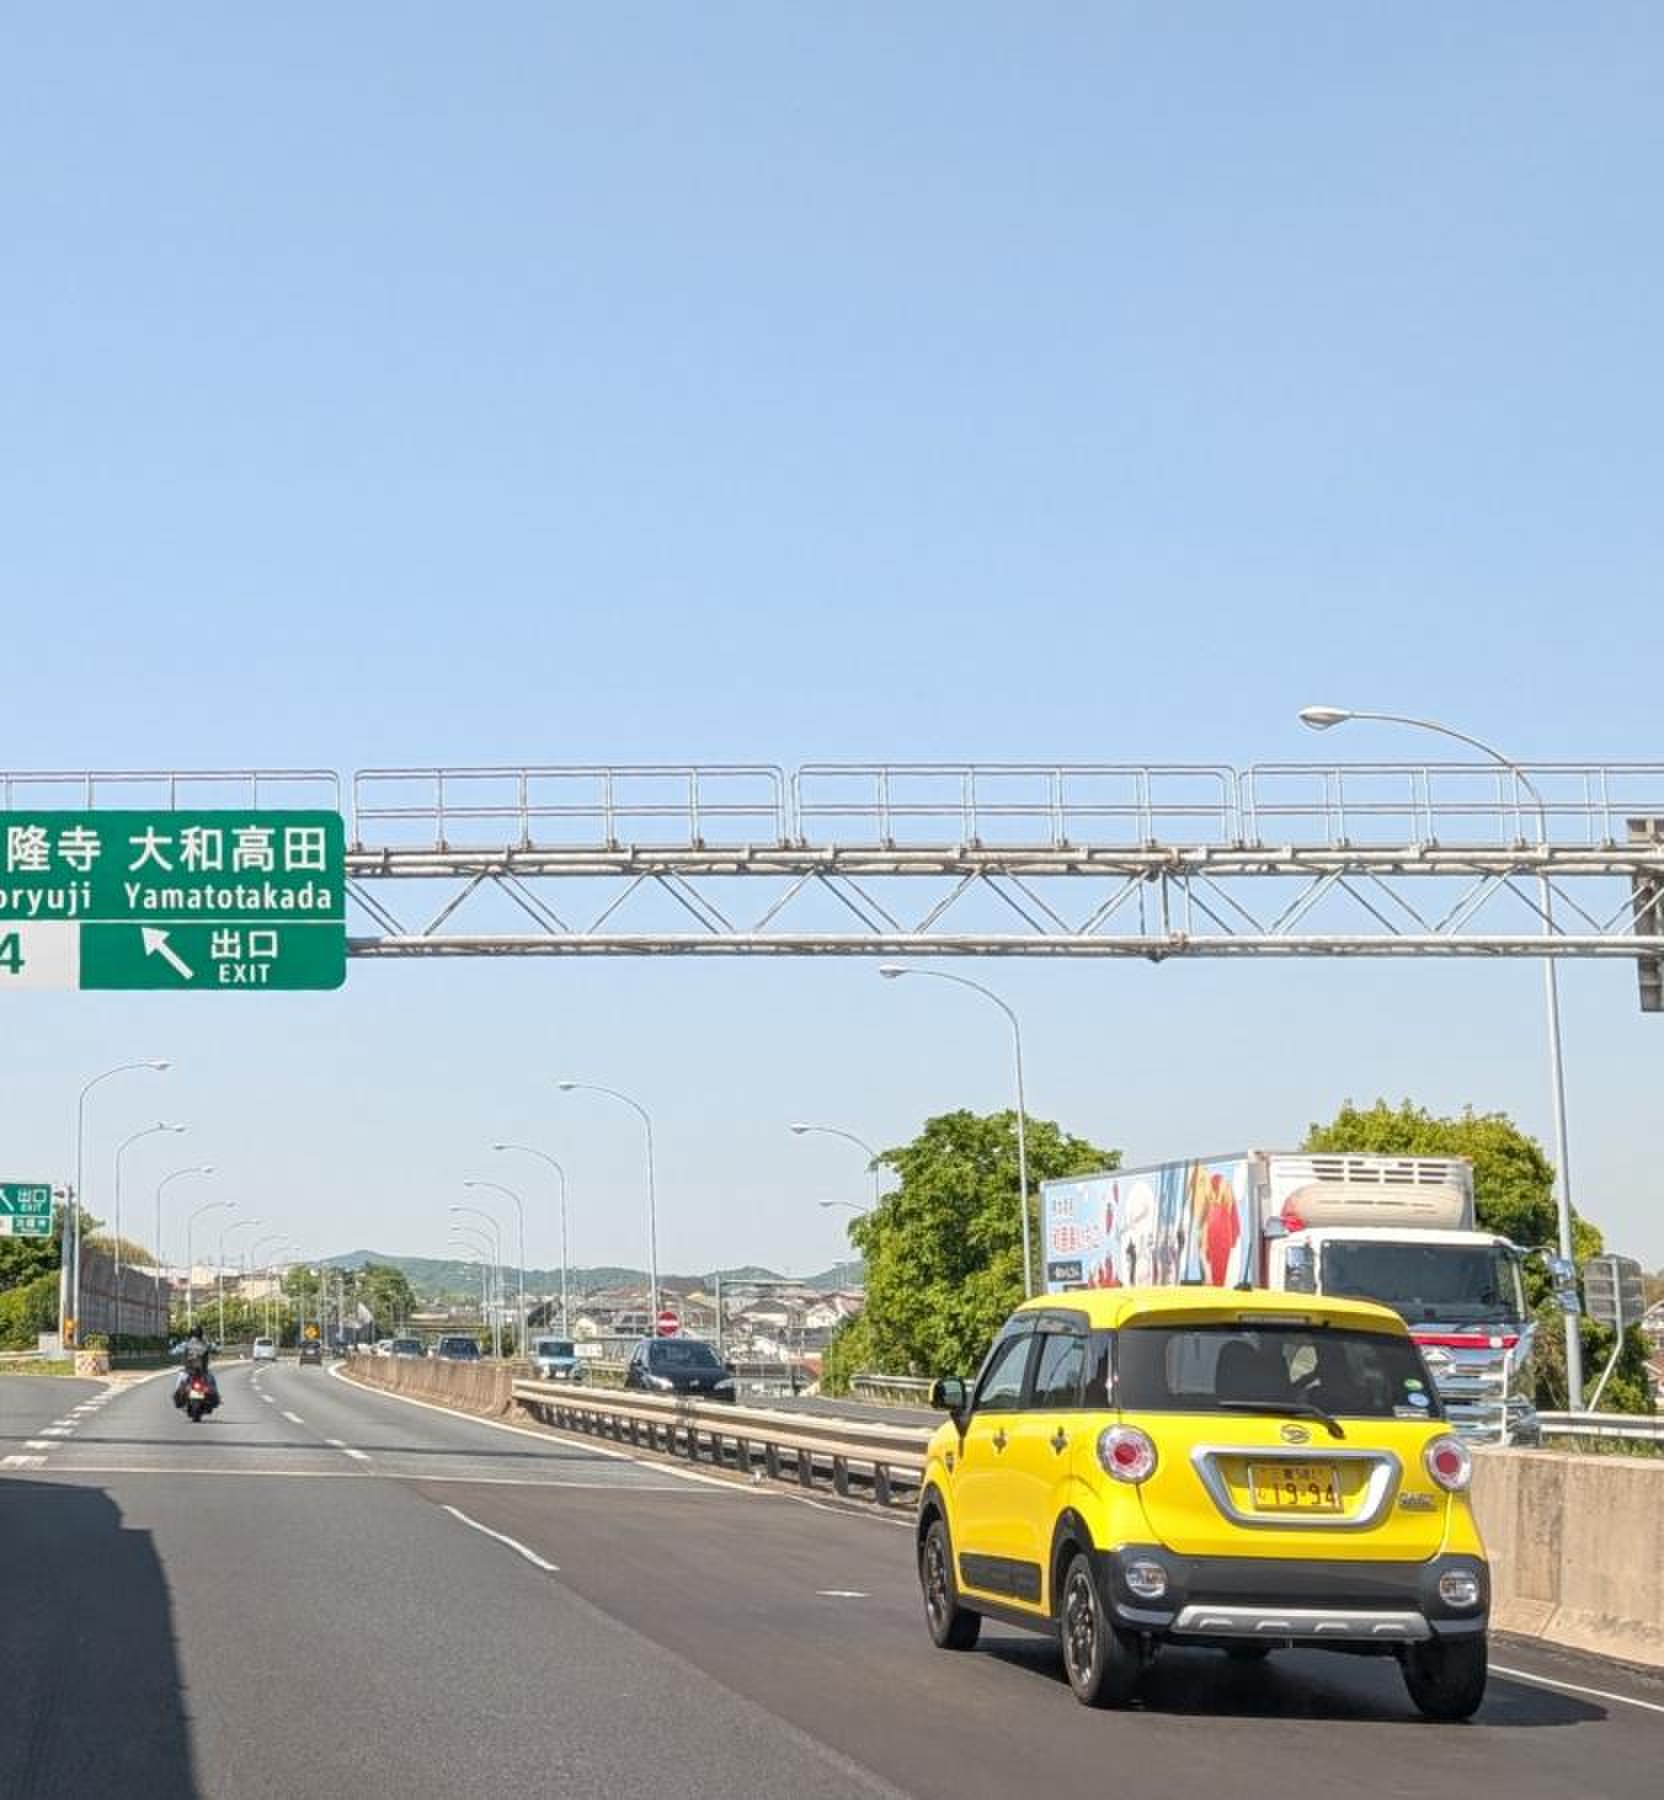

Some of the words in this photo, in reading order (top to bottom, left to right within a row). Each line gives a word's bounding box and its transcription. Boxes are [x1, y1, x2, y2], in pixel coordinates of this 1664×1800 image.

[128, 825, 326, 873] 大和高田
[124, 881, 332, 910] Yamatotakada
[210, 928, 278, 960] 出口
[219, 963, 271, 983] EXIT
